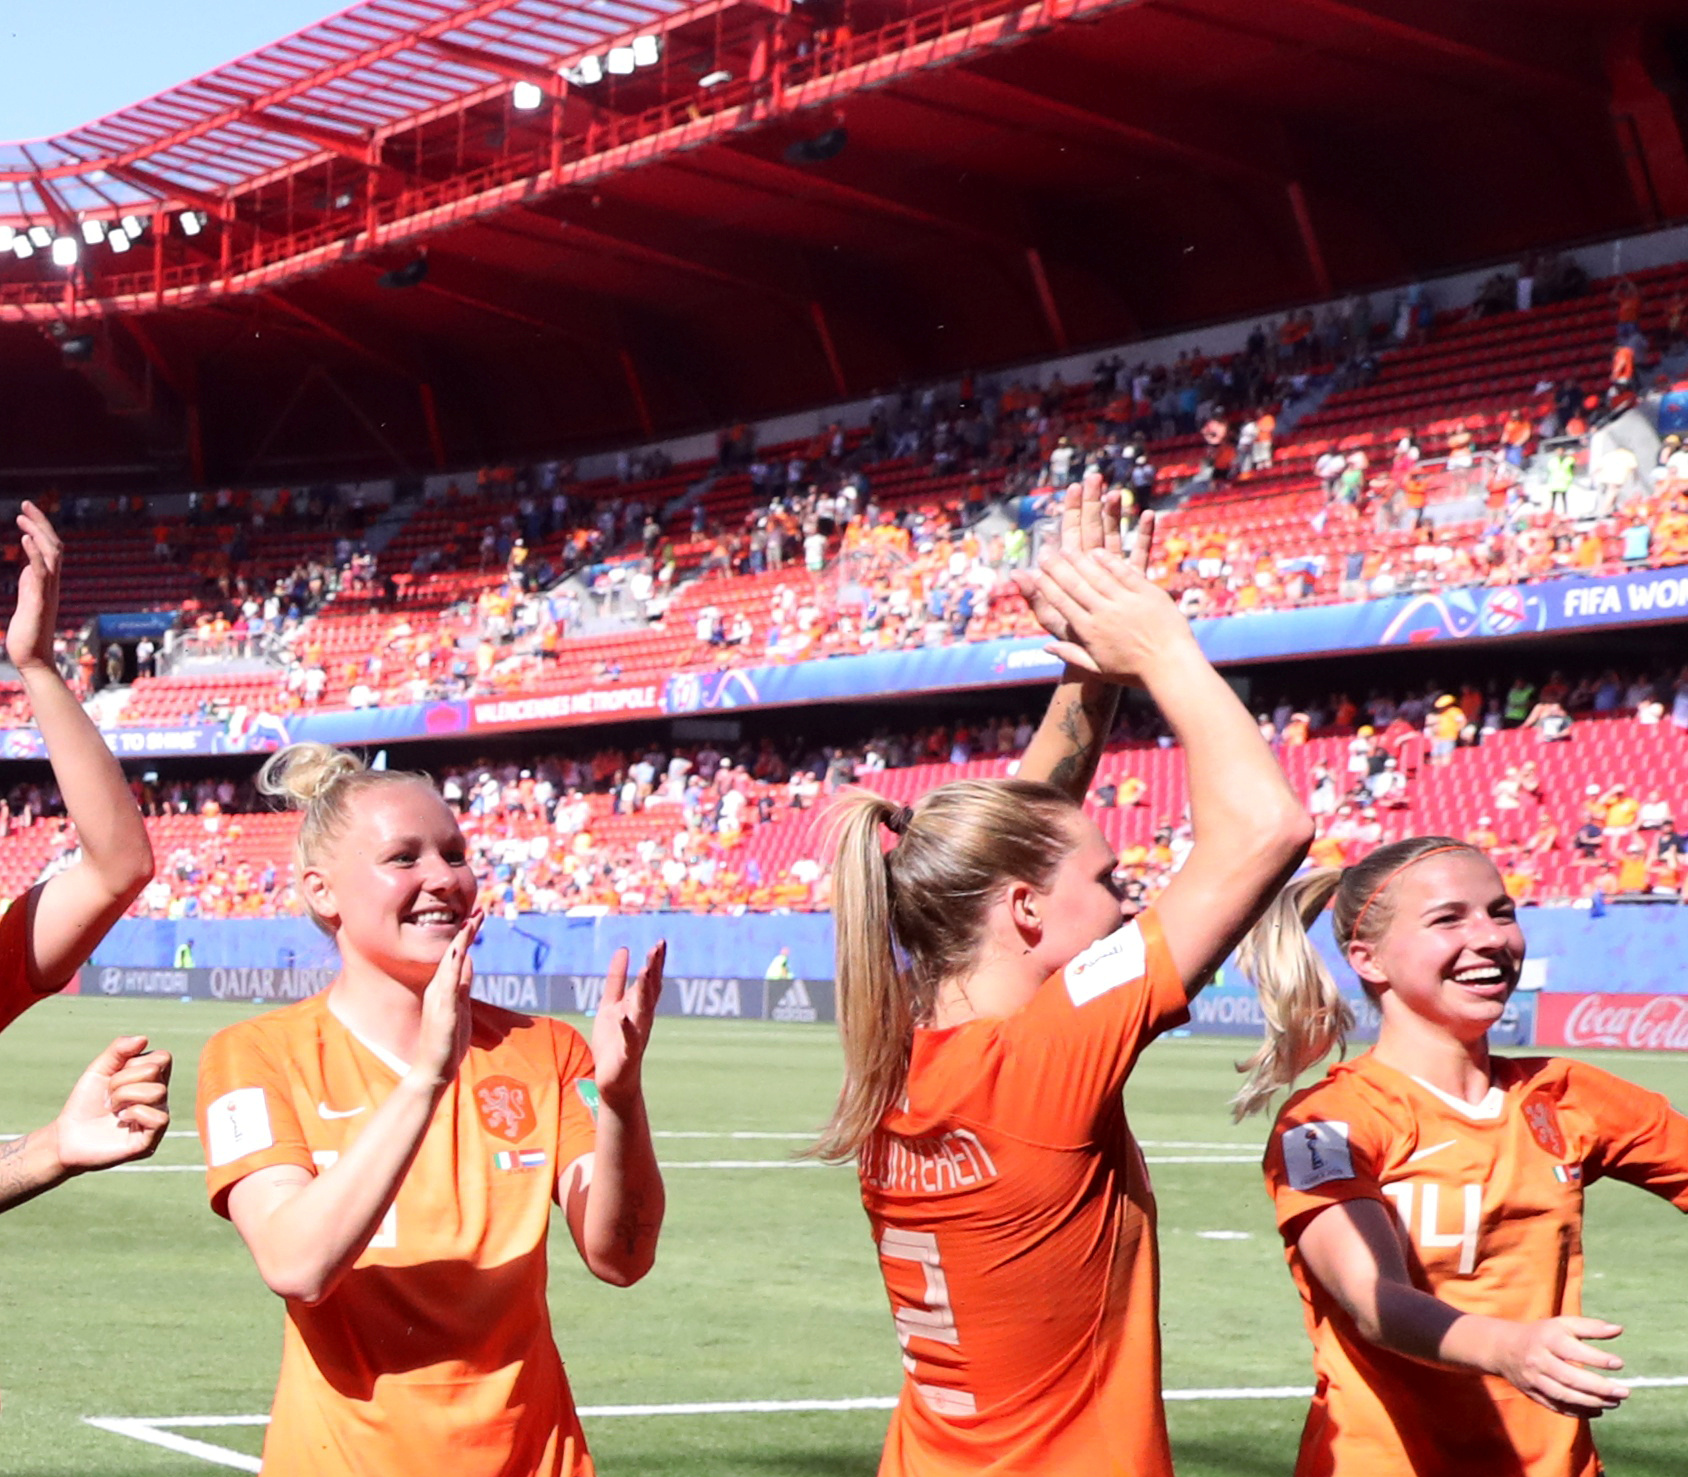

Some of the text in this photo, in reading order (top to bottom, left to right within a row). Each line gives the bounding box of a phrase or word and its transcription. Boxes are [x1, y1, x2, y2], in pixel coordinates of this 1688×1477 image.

[1563, 585, 1622, 618] FIFA
[120, 733, 145, 751] TO
[125, 970, 189, 994] HYUNDAI
[209, 967, 275, 999] QATAR
[677, 978, 741, 1017] VISA
[1197, 997, 1266, 1025] WORL
[1390, 1182, 1482, 1275] 14
[880, 1228, 977, 1416] 2
